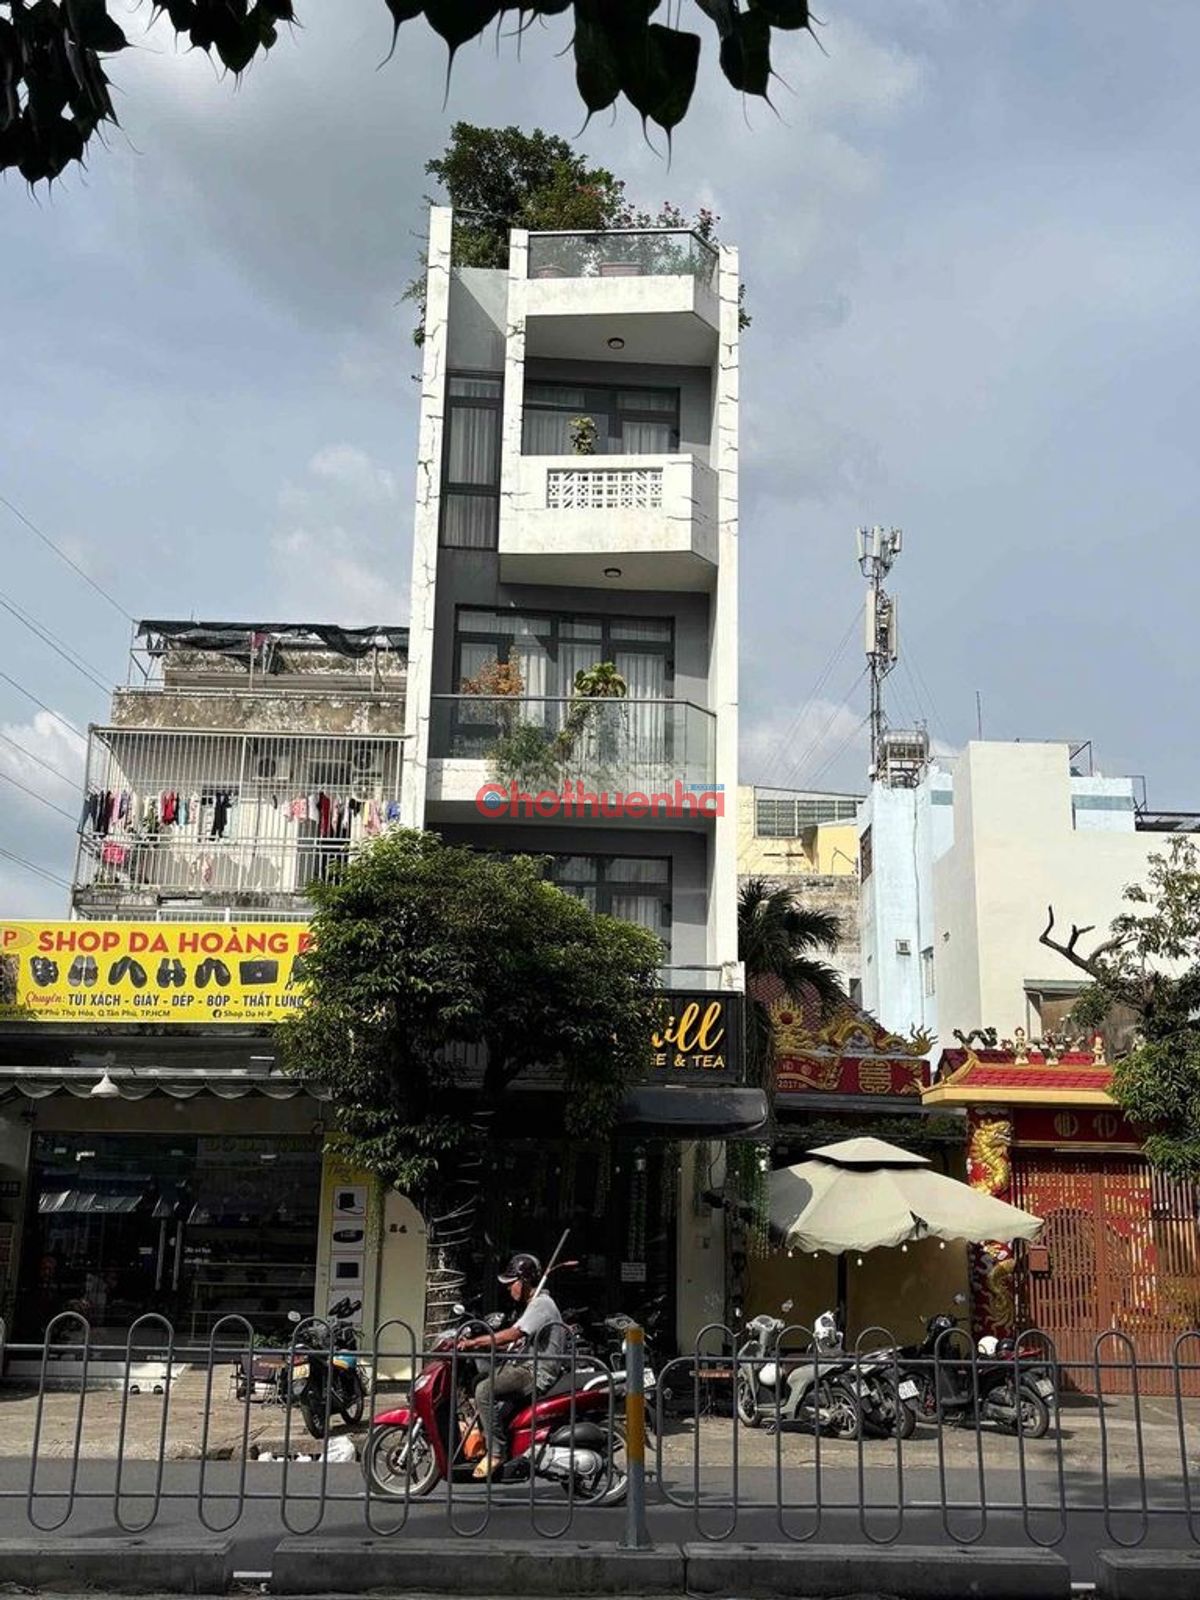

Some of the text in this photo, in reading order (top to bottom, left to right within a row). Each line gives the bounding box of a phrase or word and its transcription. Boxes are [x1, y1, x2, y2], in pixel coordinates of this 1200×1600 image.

[38, 930, 120, 952] SHOP
[128, 931, 170, 953] DA
[178, 926, 289, 953] HOÀNG
[68, 991, 86, 1006] TÚI
[90, 992, 121, 1006] XÁCH
[692, 1055, 725, 1068] TEA
